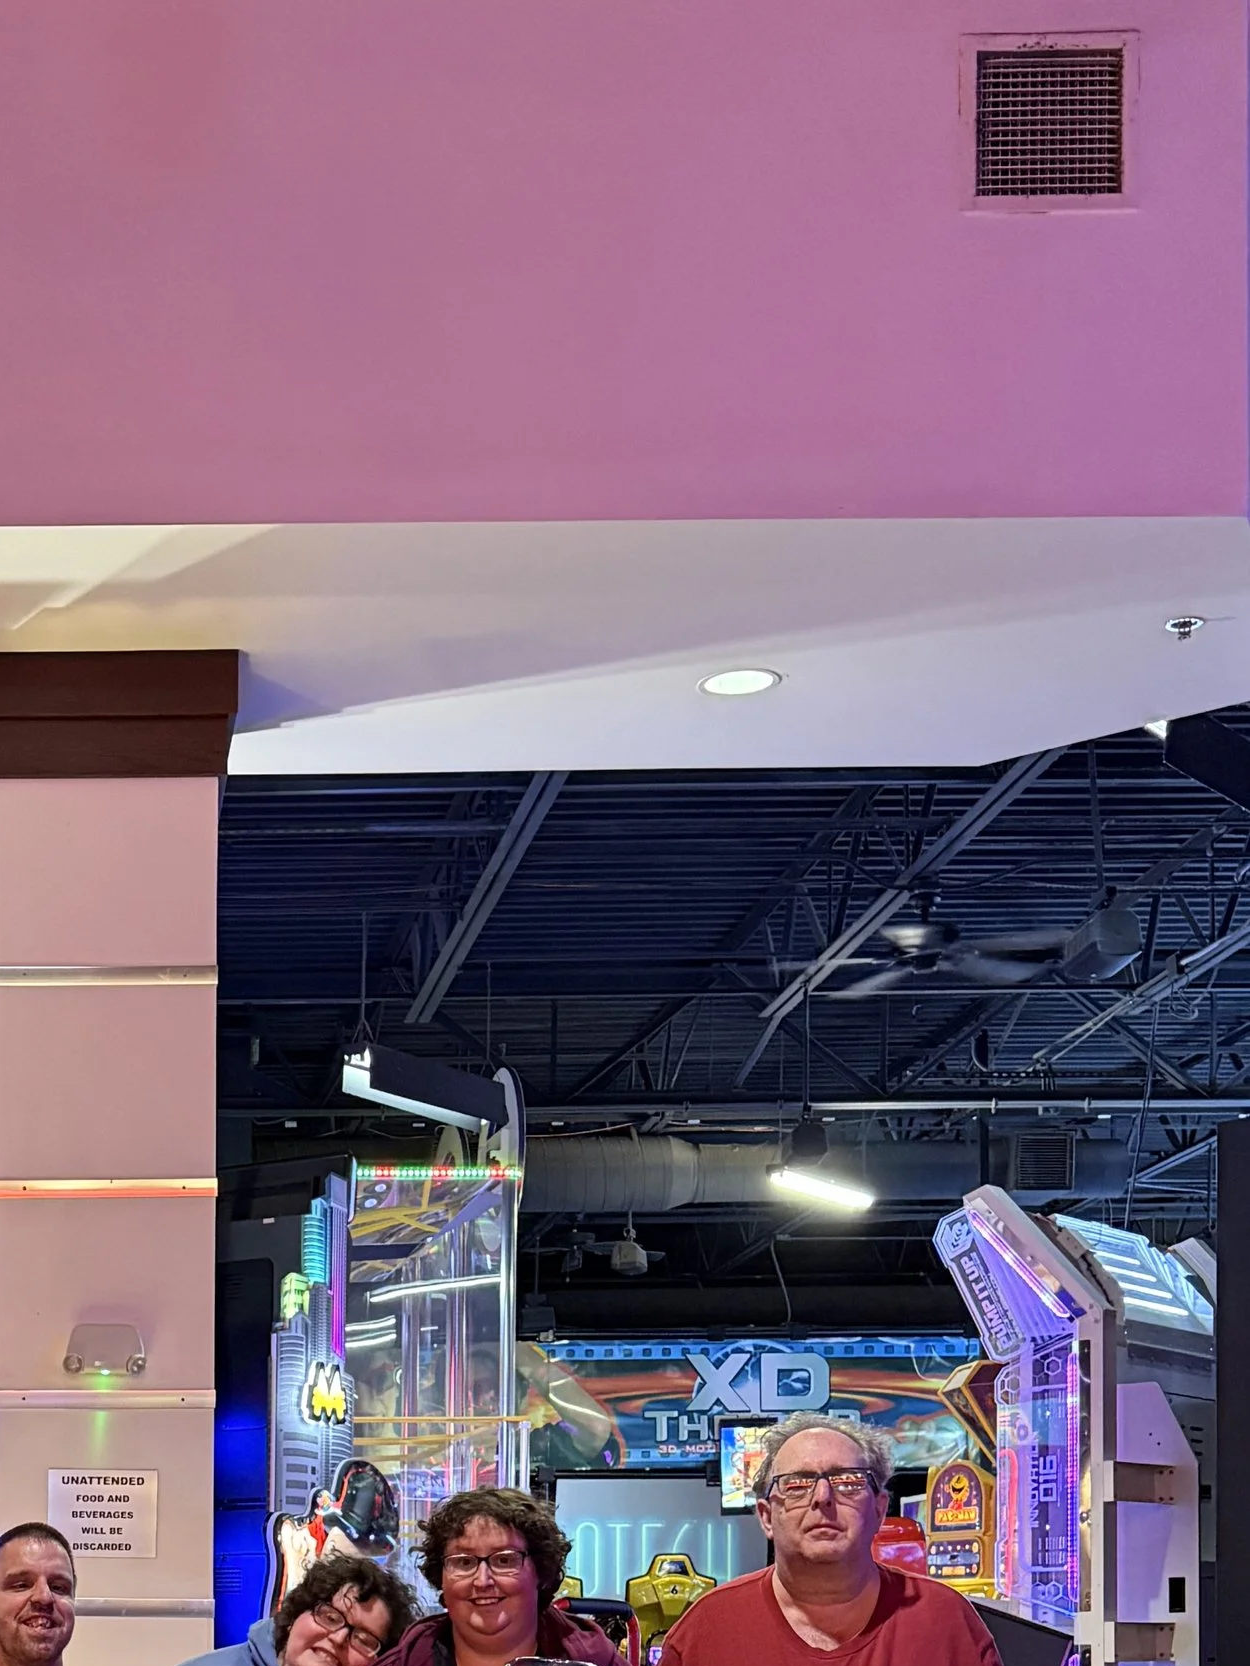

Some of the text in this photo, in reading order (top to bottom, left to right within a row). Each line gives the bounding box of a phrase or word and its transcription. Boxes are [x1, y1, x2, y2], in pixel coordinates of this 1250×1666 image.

[960, 1256, 1013, 1350] PUMP IT UP
[684, 1352, 830, 1412] XD
[61, 1476, 145, 1486] UNATTENDED
[107, 1495, 130, 1503] AND
[71, 1511, 134, 1519] BEVERAGES
[936, 1509, 978, 1523] PAC-MAN
[109, 1527, 123, 1535] BE
[72, 1543, 132, 1551] DISCARDED
